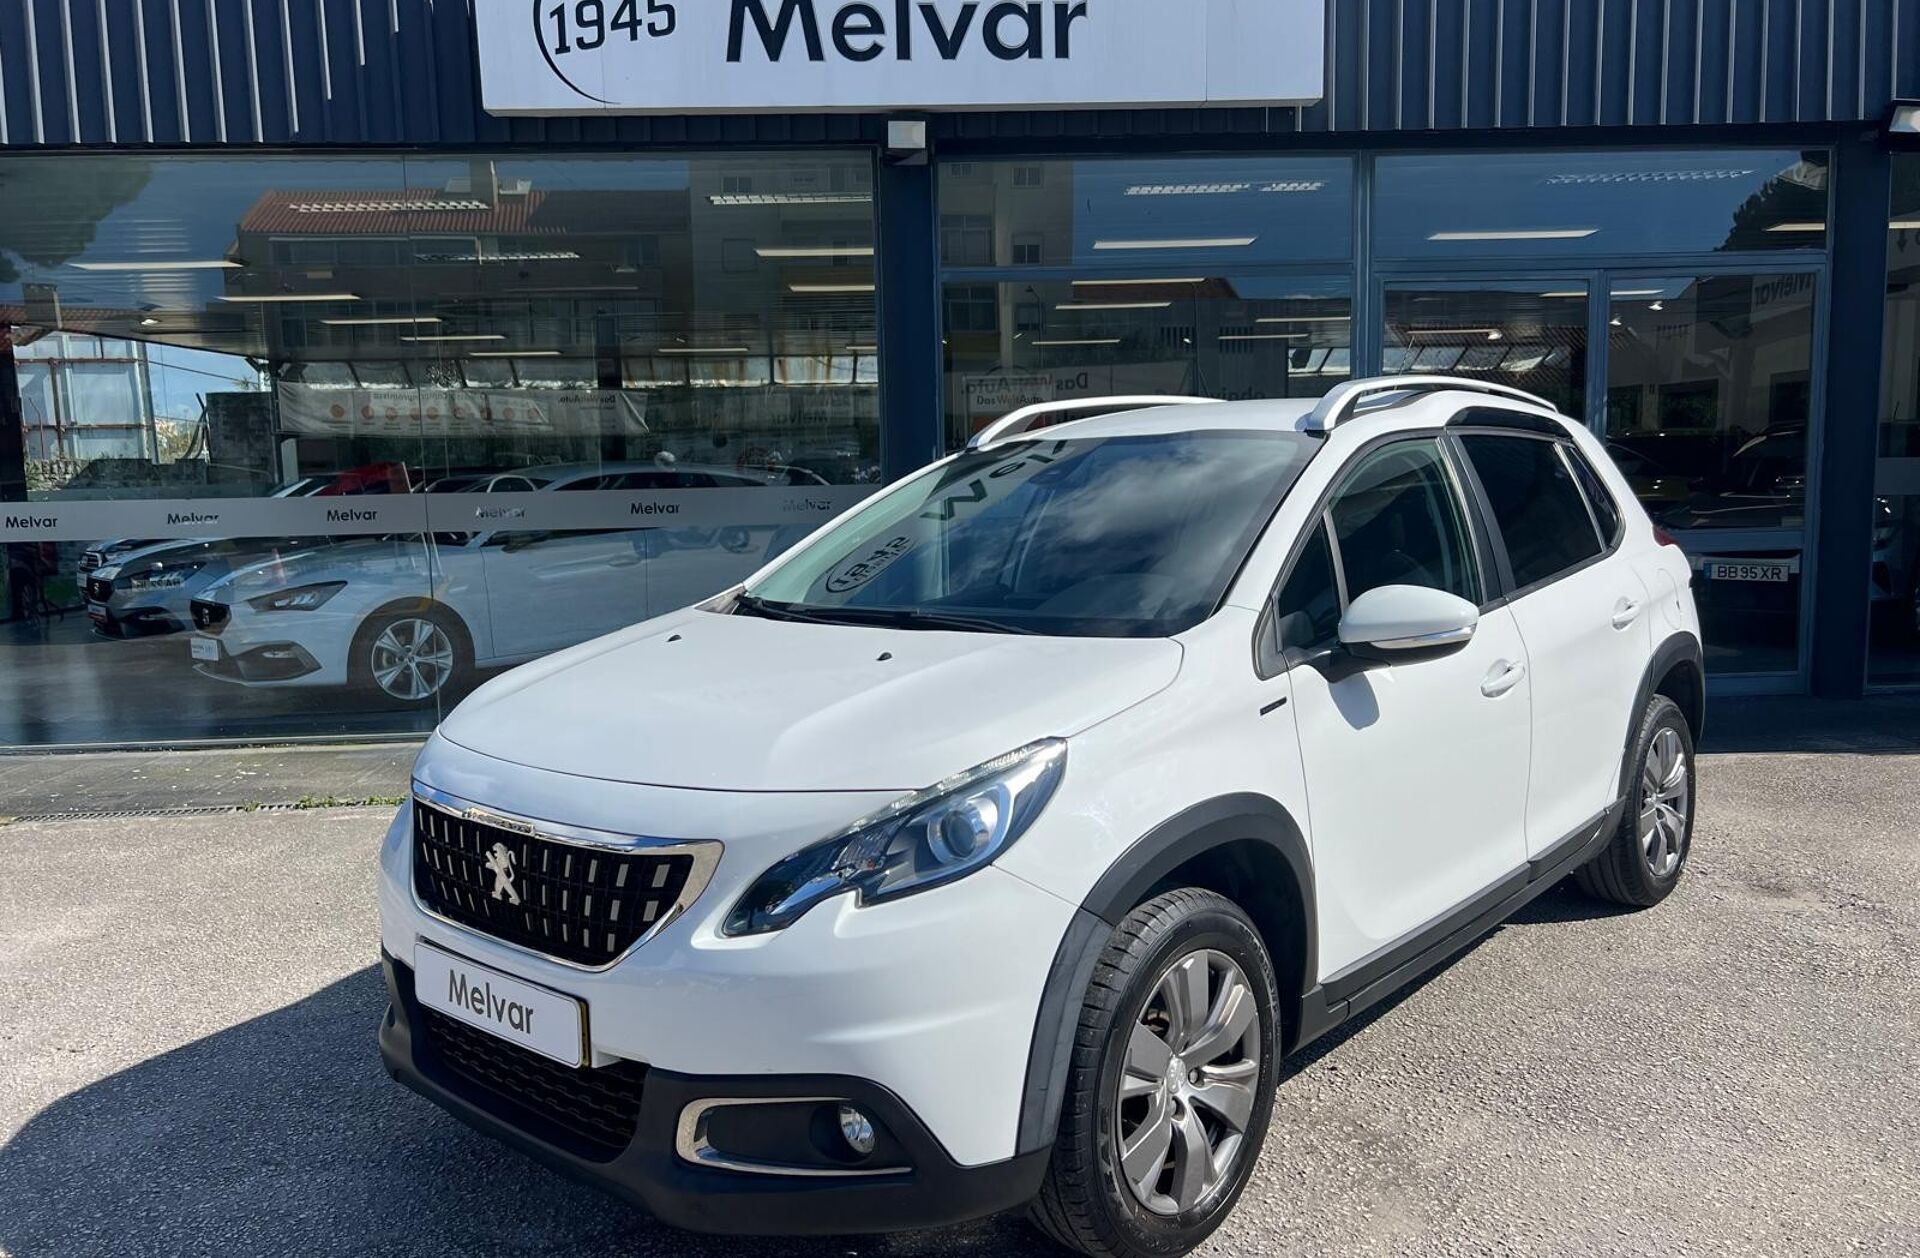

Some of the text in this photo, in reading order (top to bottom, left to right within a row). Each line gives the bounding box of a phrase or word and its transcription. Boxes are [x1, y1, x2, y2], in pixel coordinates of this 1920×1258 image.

[549, 0, 676, 54] 1945
[726, 0, 1088, 62] Melvar
[326, 508, 378, 522] Melvar
[630, 501, 681, 515] Melvar
[5, 515, 58, 528] Melvar
[167, 512, 220, 524] Melvar
[448, 969, 534, 1036] Melvar
